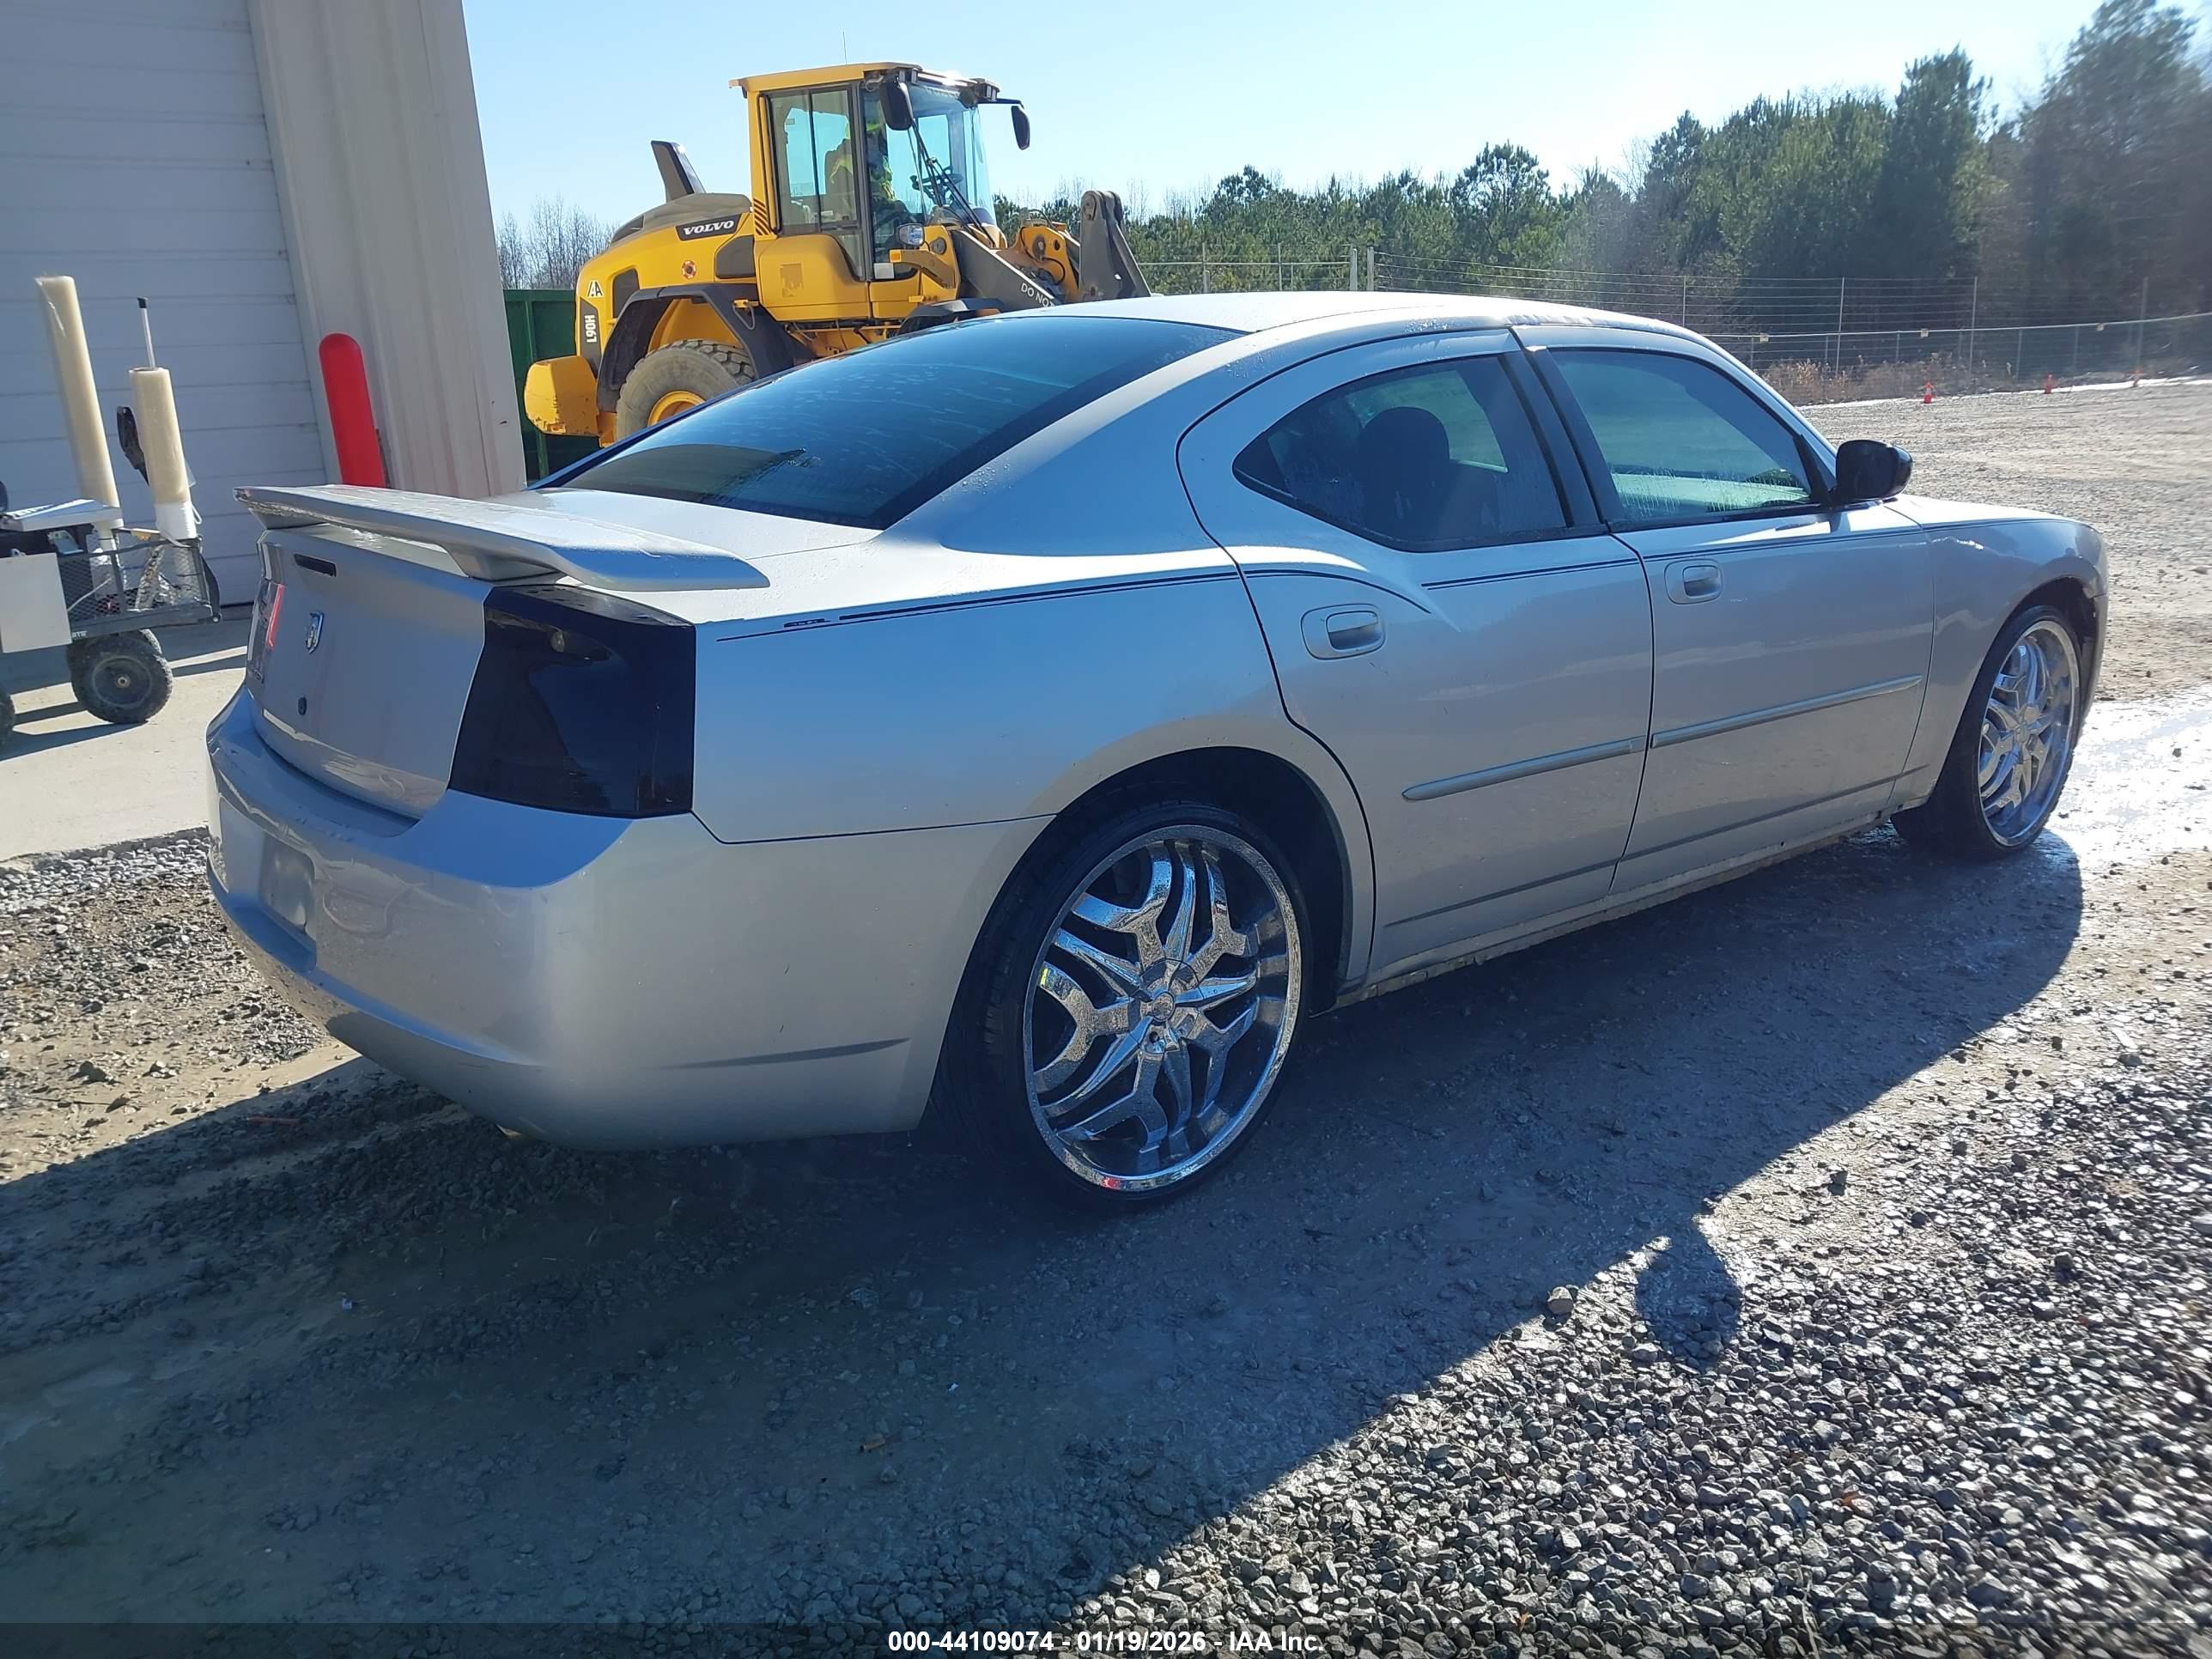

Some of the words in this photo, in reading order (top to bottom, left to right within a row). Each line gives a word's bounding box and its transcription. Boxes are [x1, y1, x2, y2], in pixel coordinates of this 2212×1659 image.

[683, 220, 734, 235] VOLVO
[1021, 283, 1035, 297] DO
[584, 314, 598, 343] L90H
